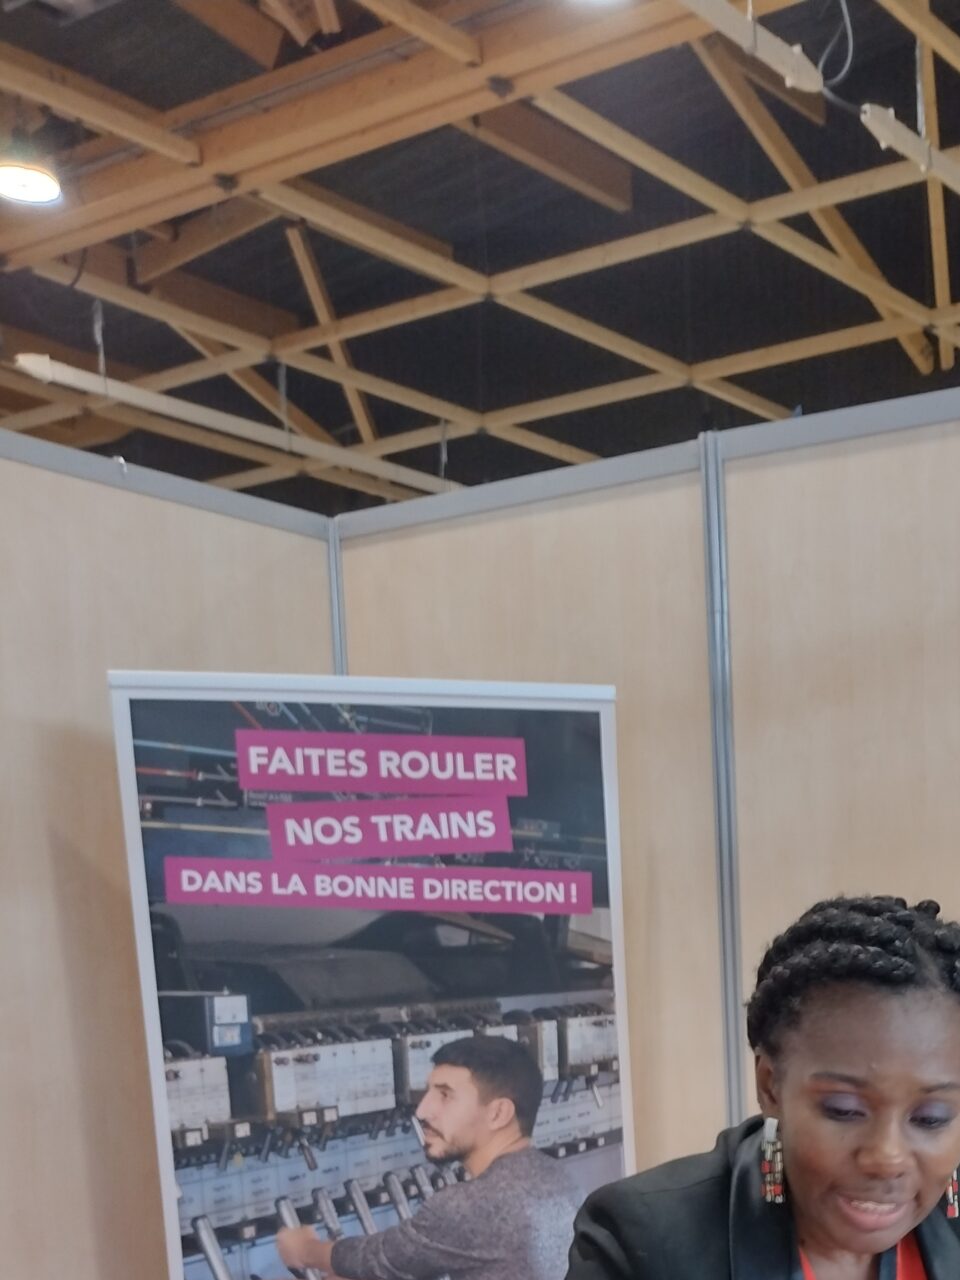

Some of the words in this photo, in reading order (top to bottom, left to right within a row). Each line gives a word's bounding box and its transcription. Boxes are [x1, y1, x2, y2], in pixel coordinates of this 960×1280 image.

[248, 745, 368, 778] FAITES
[379, 750, 518, 781] ROULER
[284, 815, 363, 846] NOS
[370, 810, 497, 842] TRAINS
[180, 869, 263, 894] DANS
[271, 872, 307, 896] LA
[314, 874, 415, 899] BONNE
[423, 878, 566, 903] DIRECTION
[570, 882, 578, 904] !
